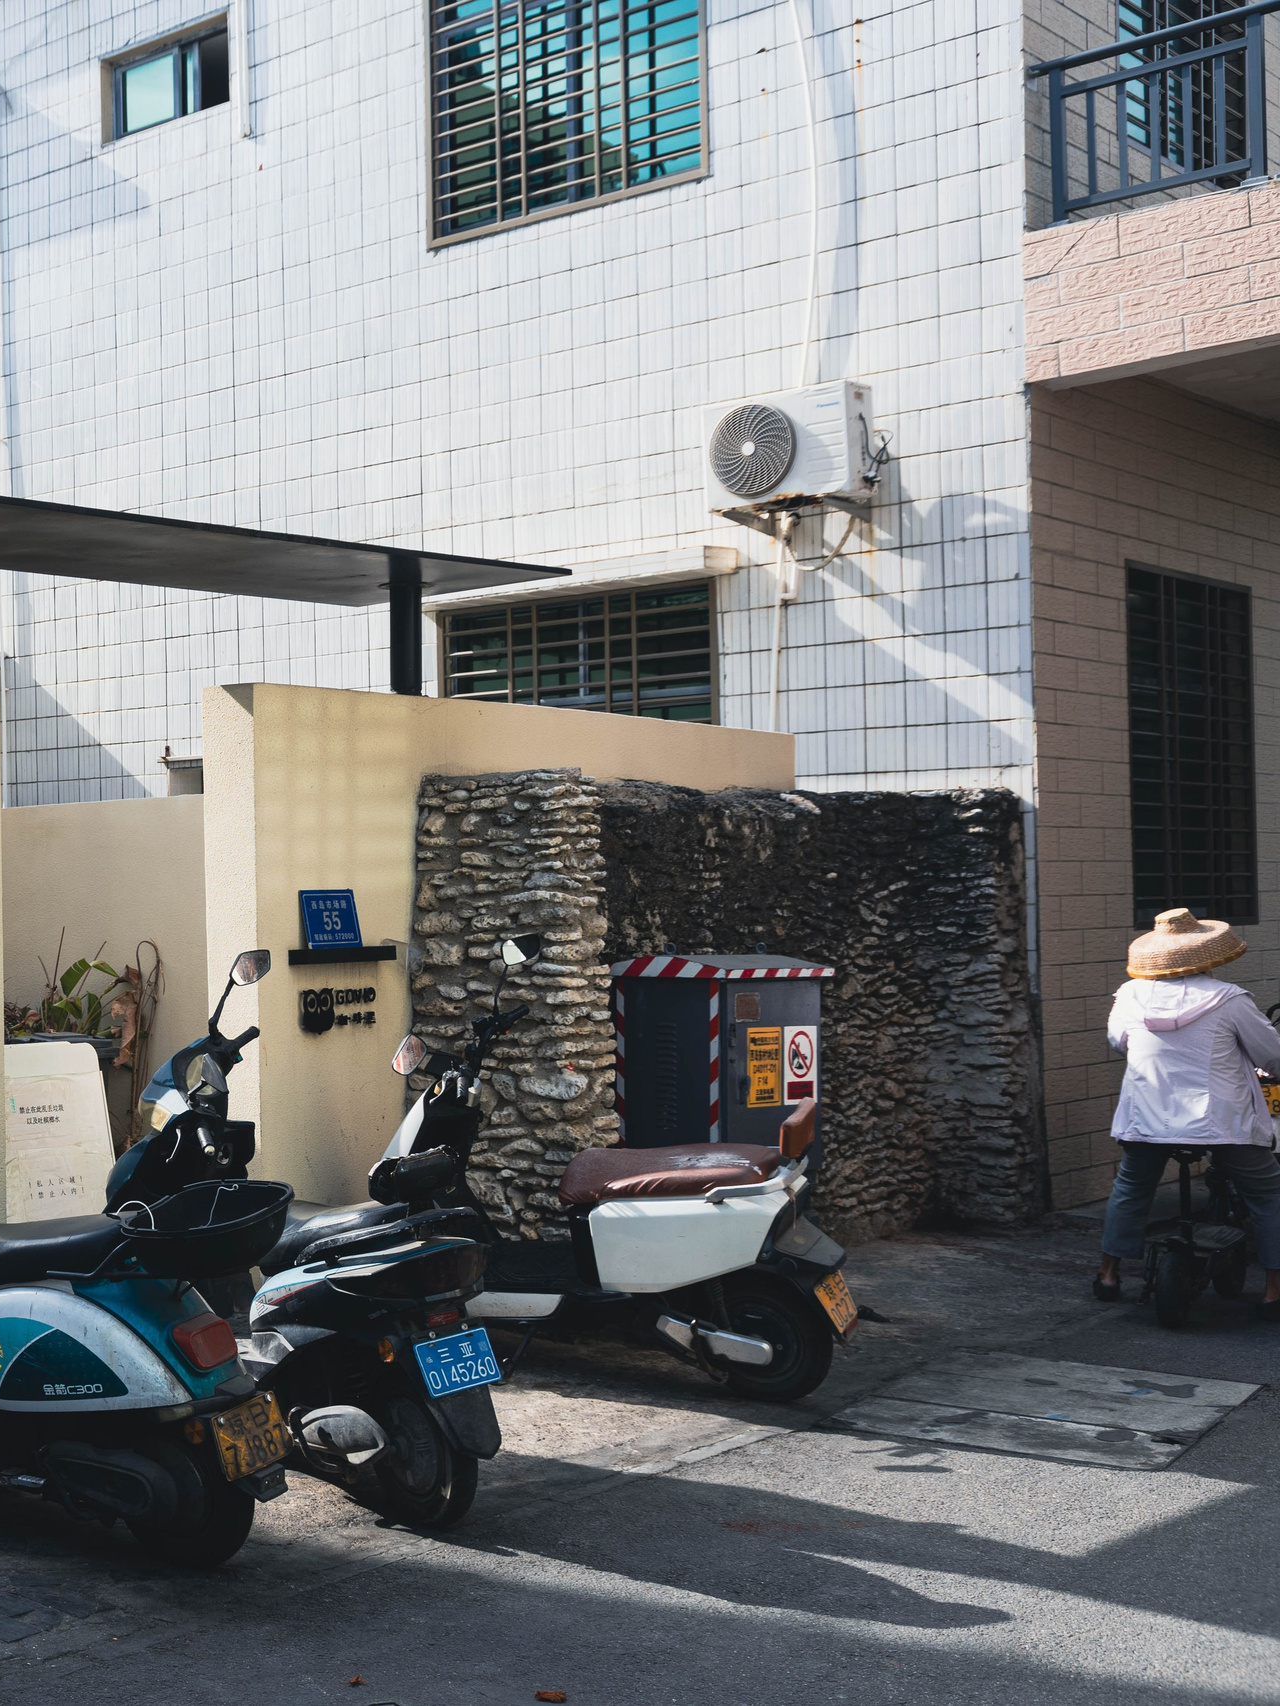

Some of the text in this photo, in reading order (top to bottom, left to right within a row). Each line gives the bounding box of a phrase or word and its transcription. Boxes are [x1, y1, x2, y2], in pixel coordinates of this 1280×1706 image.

[322, 911, 342, 931] 55
[334, 932, 355, 940] 572000
[428, 1356, 497, 1391] 0145260
